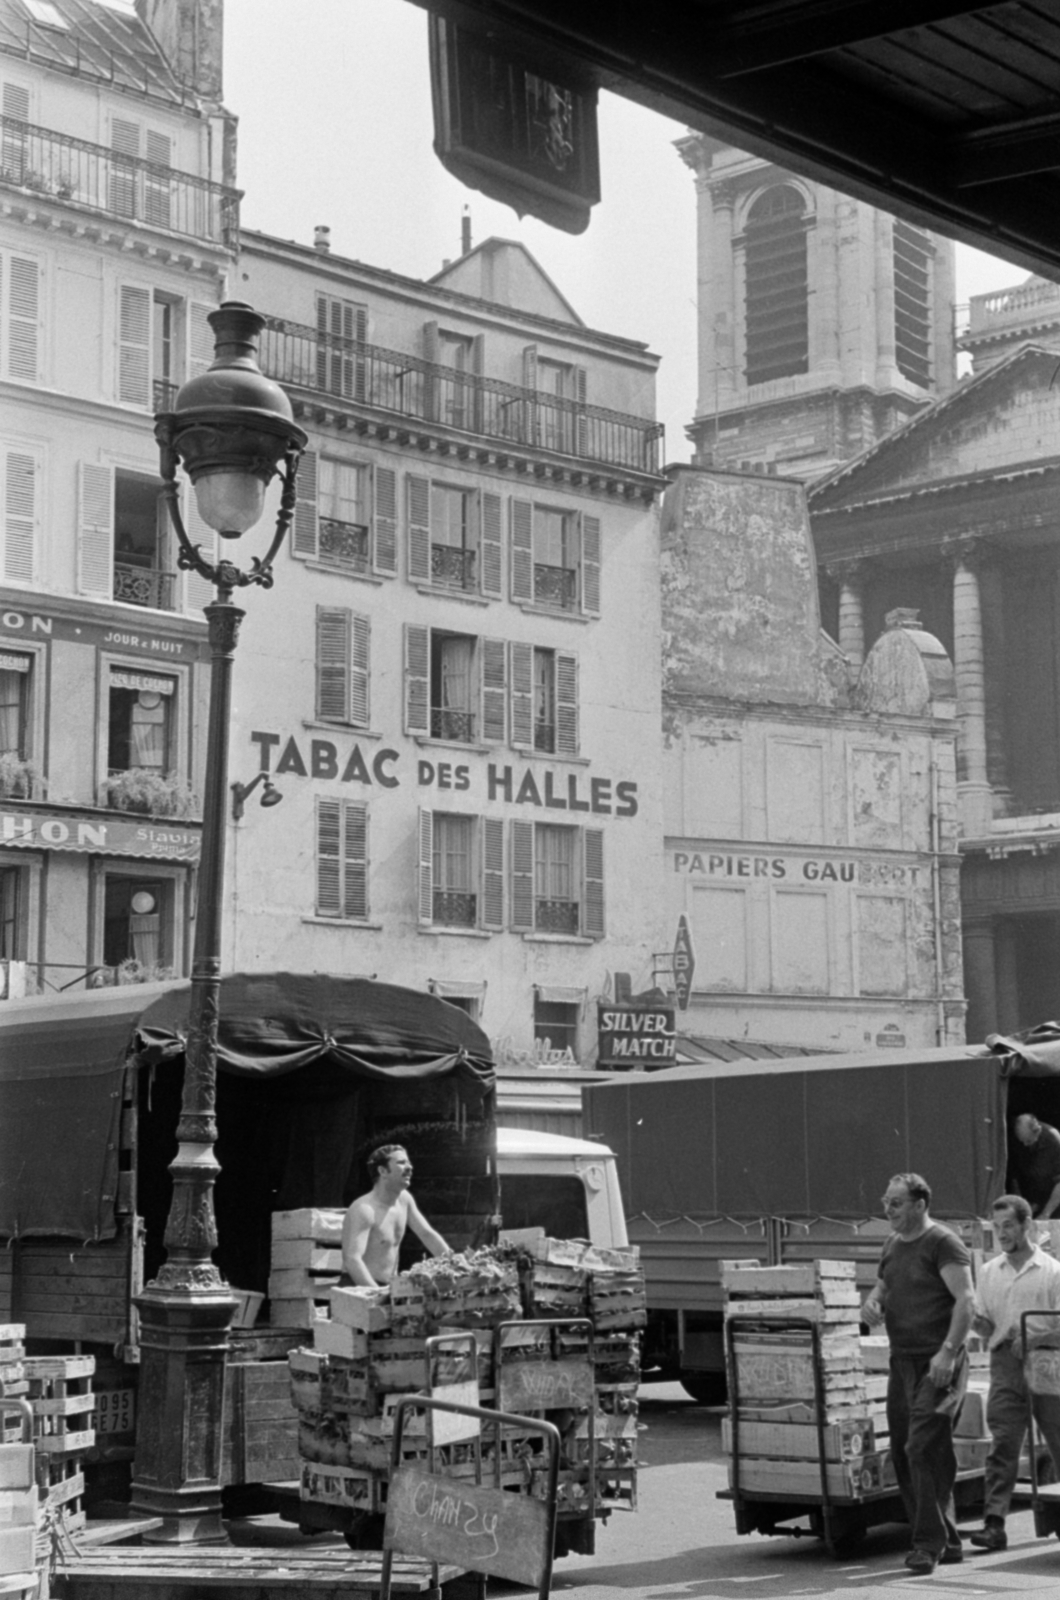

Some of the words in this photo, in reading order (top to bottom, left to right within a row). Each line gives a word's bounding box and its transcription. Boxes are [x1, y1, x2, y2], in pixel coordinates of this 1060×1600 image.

[104, 632, 139, 648] JOUR
[151, 639, 183, 653] NUIT
[251, 731, 400, 789] TABAC
[418, 760, 470, 790] DES
[487, 763, 638, 817] HALLES
[674, 853, 786, 878] PAPIERS
[675, 927, 689, 998] TABAC
[601, 1012, 676, 1035] SILVER
[612, 1038, 675, 1057] MATCH
